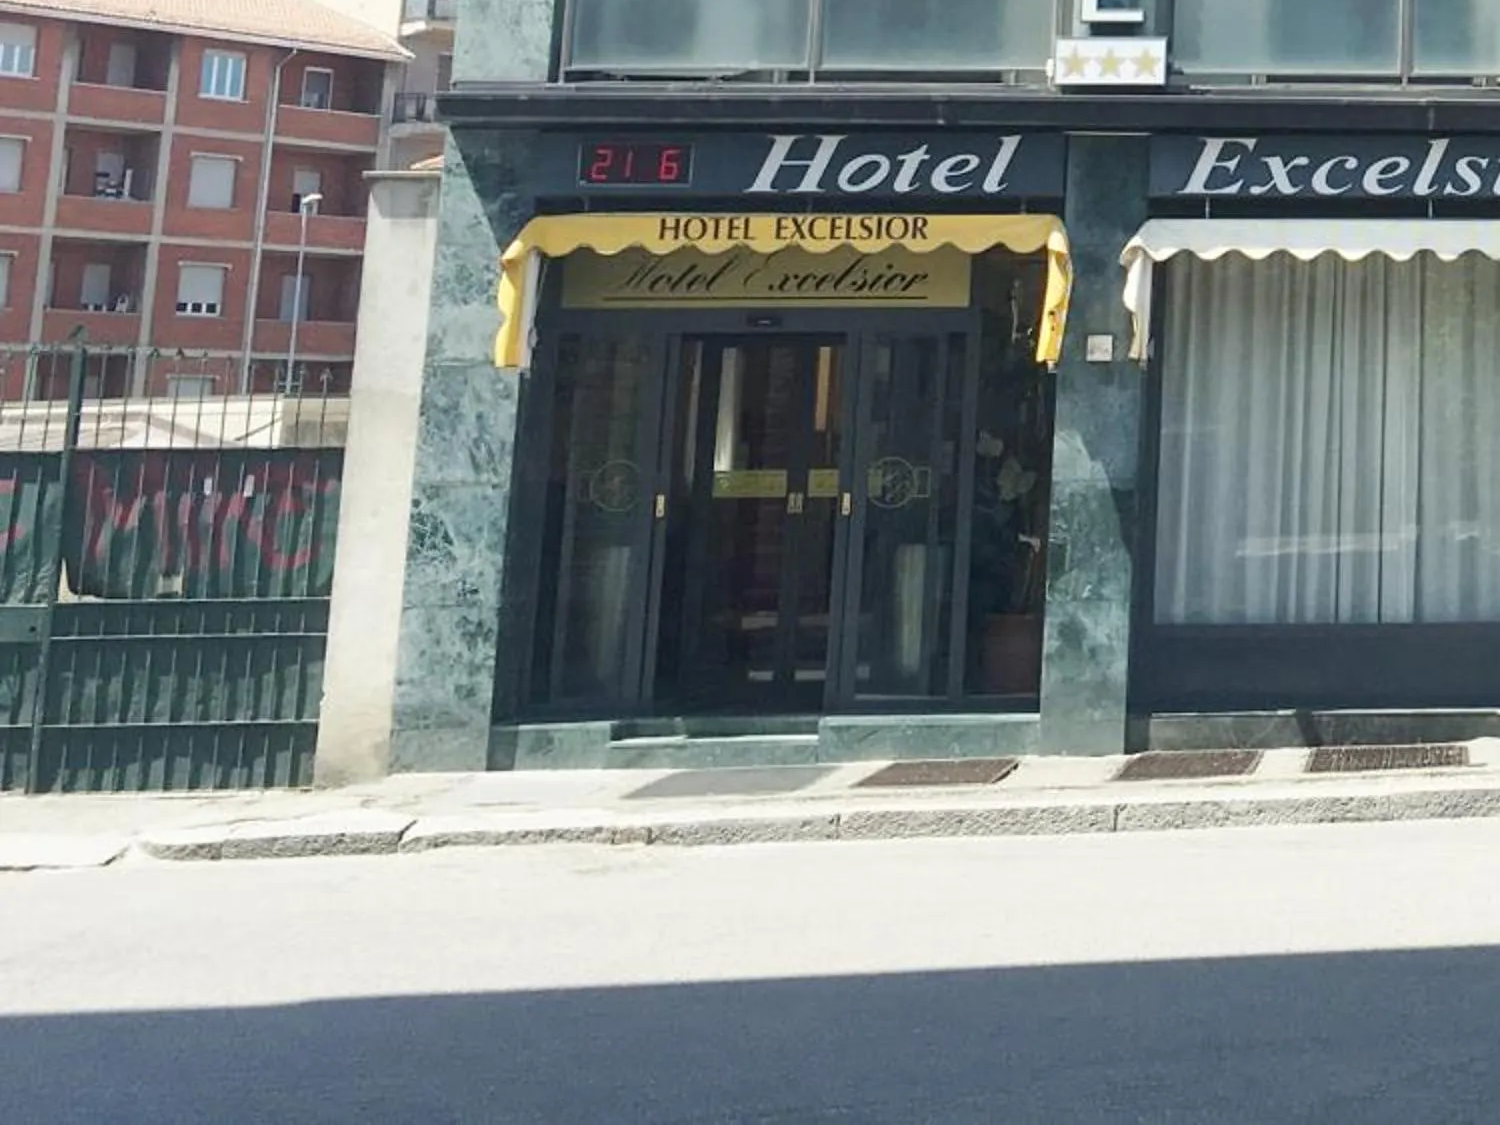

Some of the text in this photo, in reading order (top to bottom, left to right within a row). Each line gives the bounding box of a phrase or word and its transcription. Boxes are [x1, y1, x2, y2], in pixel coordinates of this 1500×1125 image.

[742, 134, 1024, 194] Hotel
[658, 215, 929, 242] HOTEL EXCELSIOR
[615, 250, 929, 293] Hotel Excelsior
